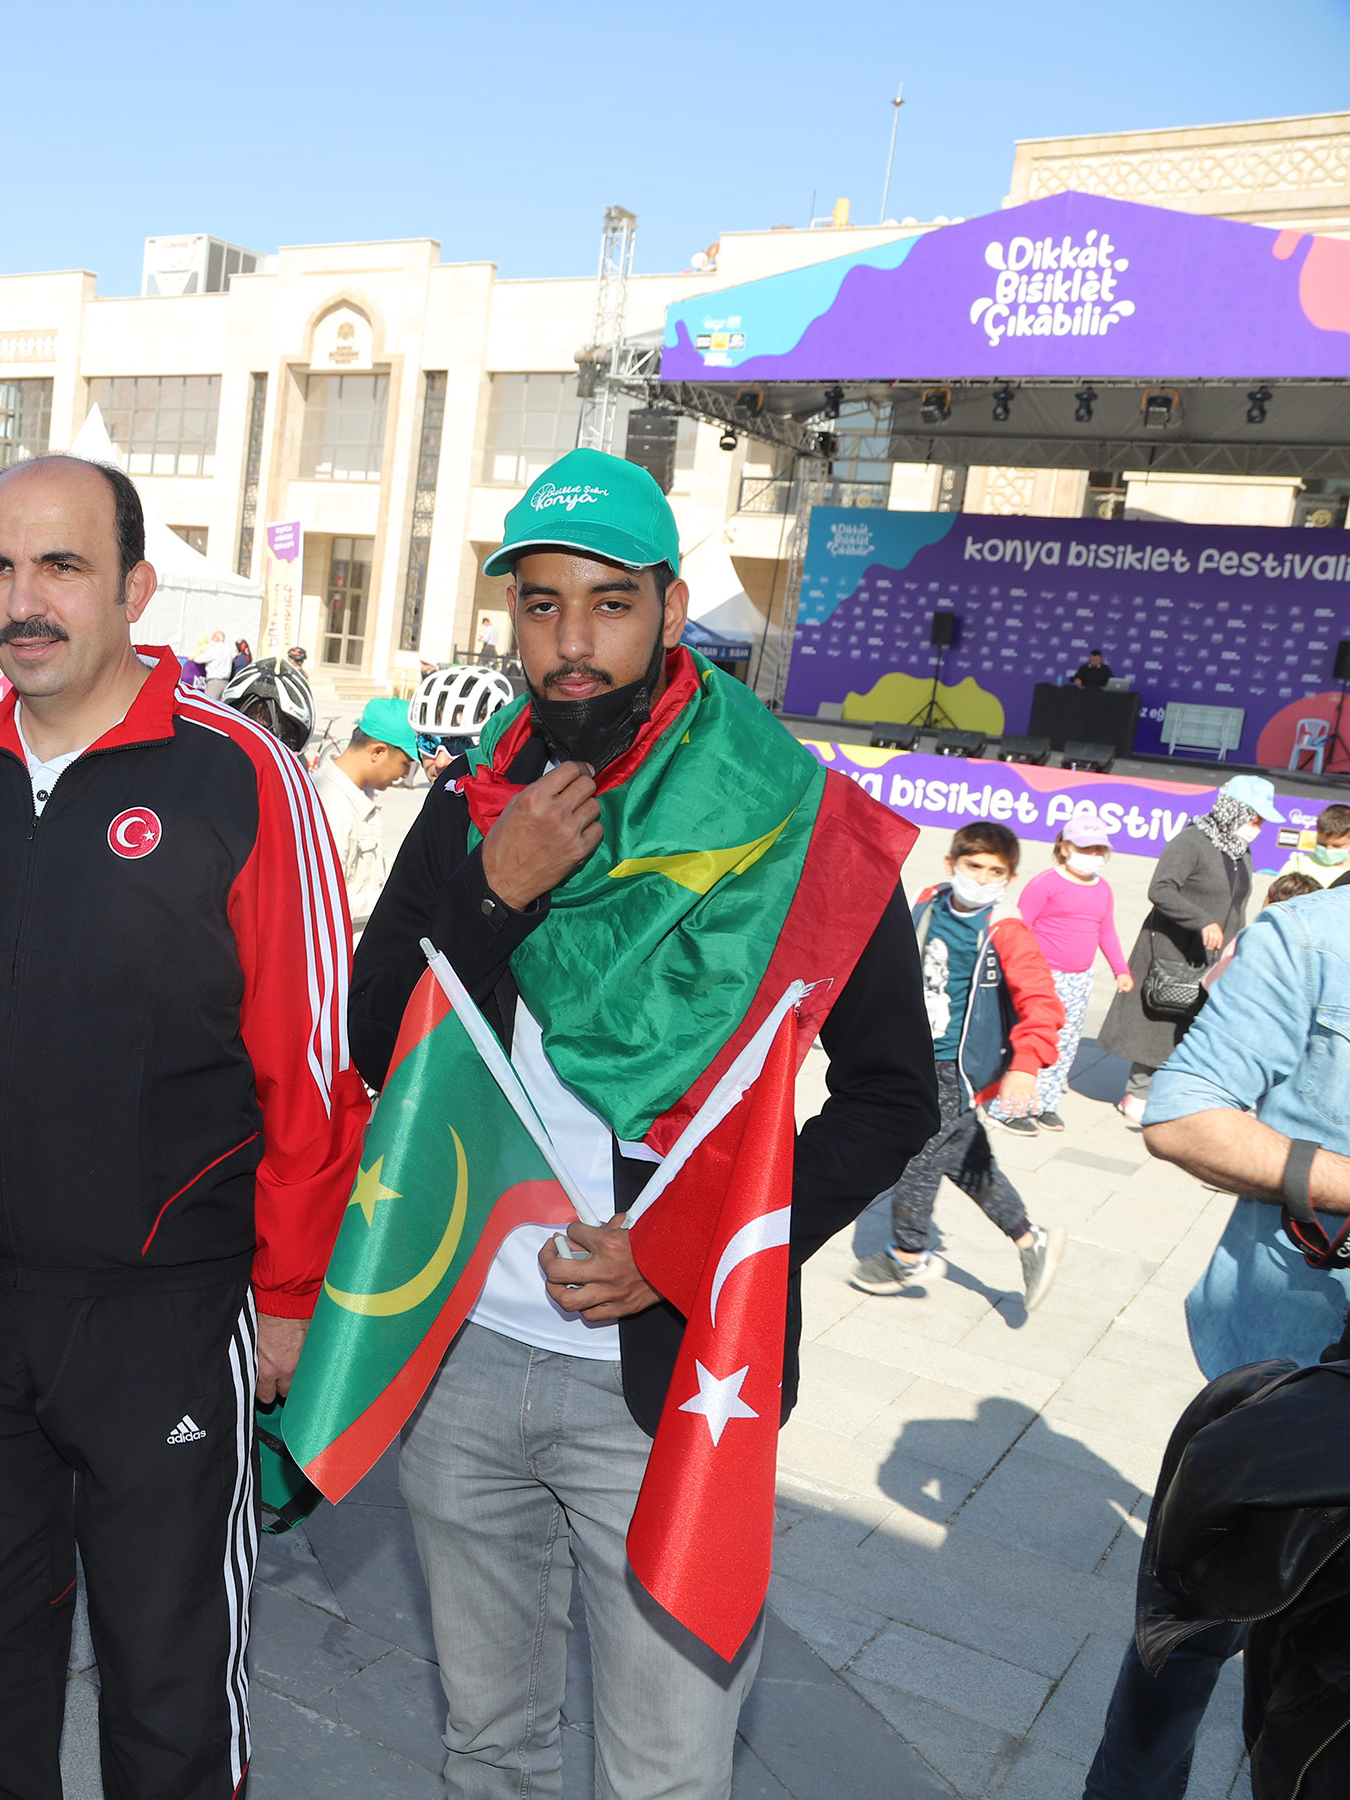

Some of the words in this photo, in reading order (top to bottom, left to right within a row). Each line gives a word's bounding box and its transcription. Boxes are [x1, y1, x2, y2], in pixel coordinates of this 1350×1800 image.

[535, 492, 598, 512] Konya
[964, 536, 1061, 572] konya
[1067, 541, 1191, 574] bisiklet
[889, 773, 1039, 824] bisiklet
[166, 1430, 207, 1445] adidas
